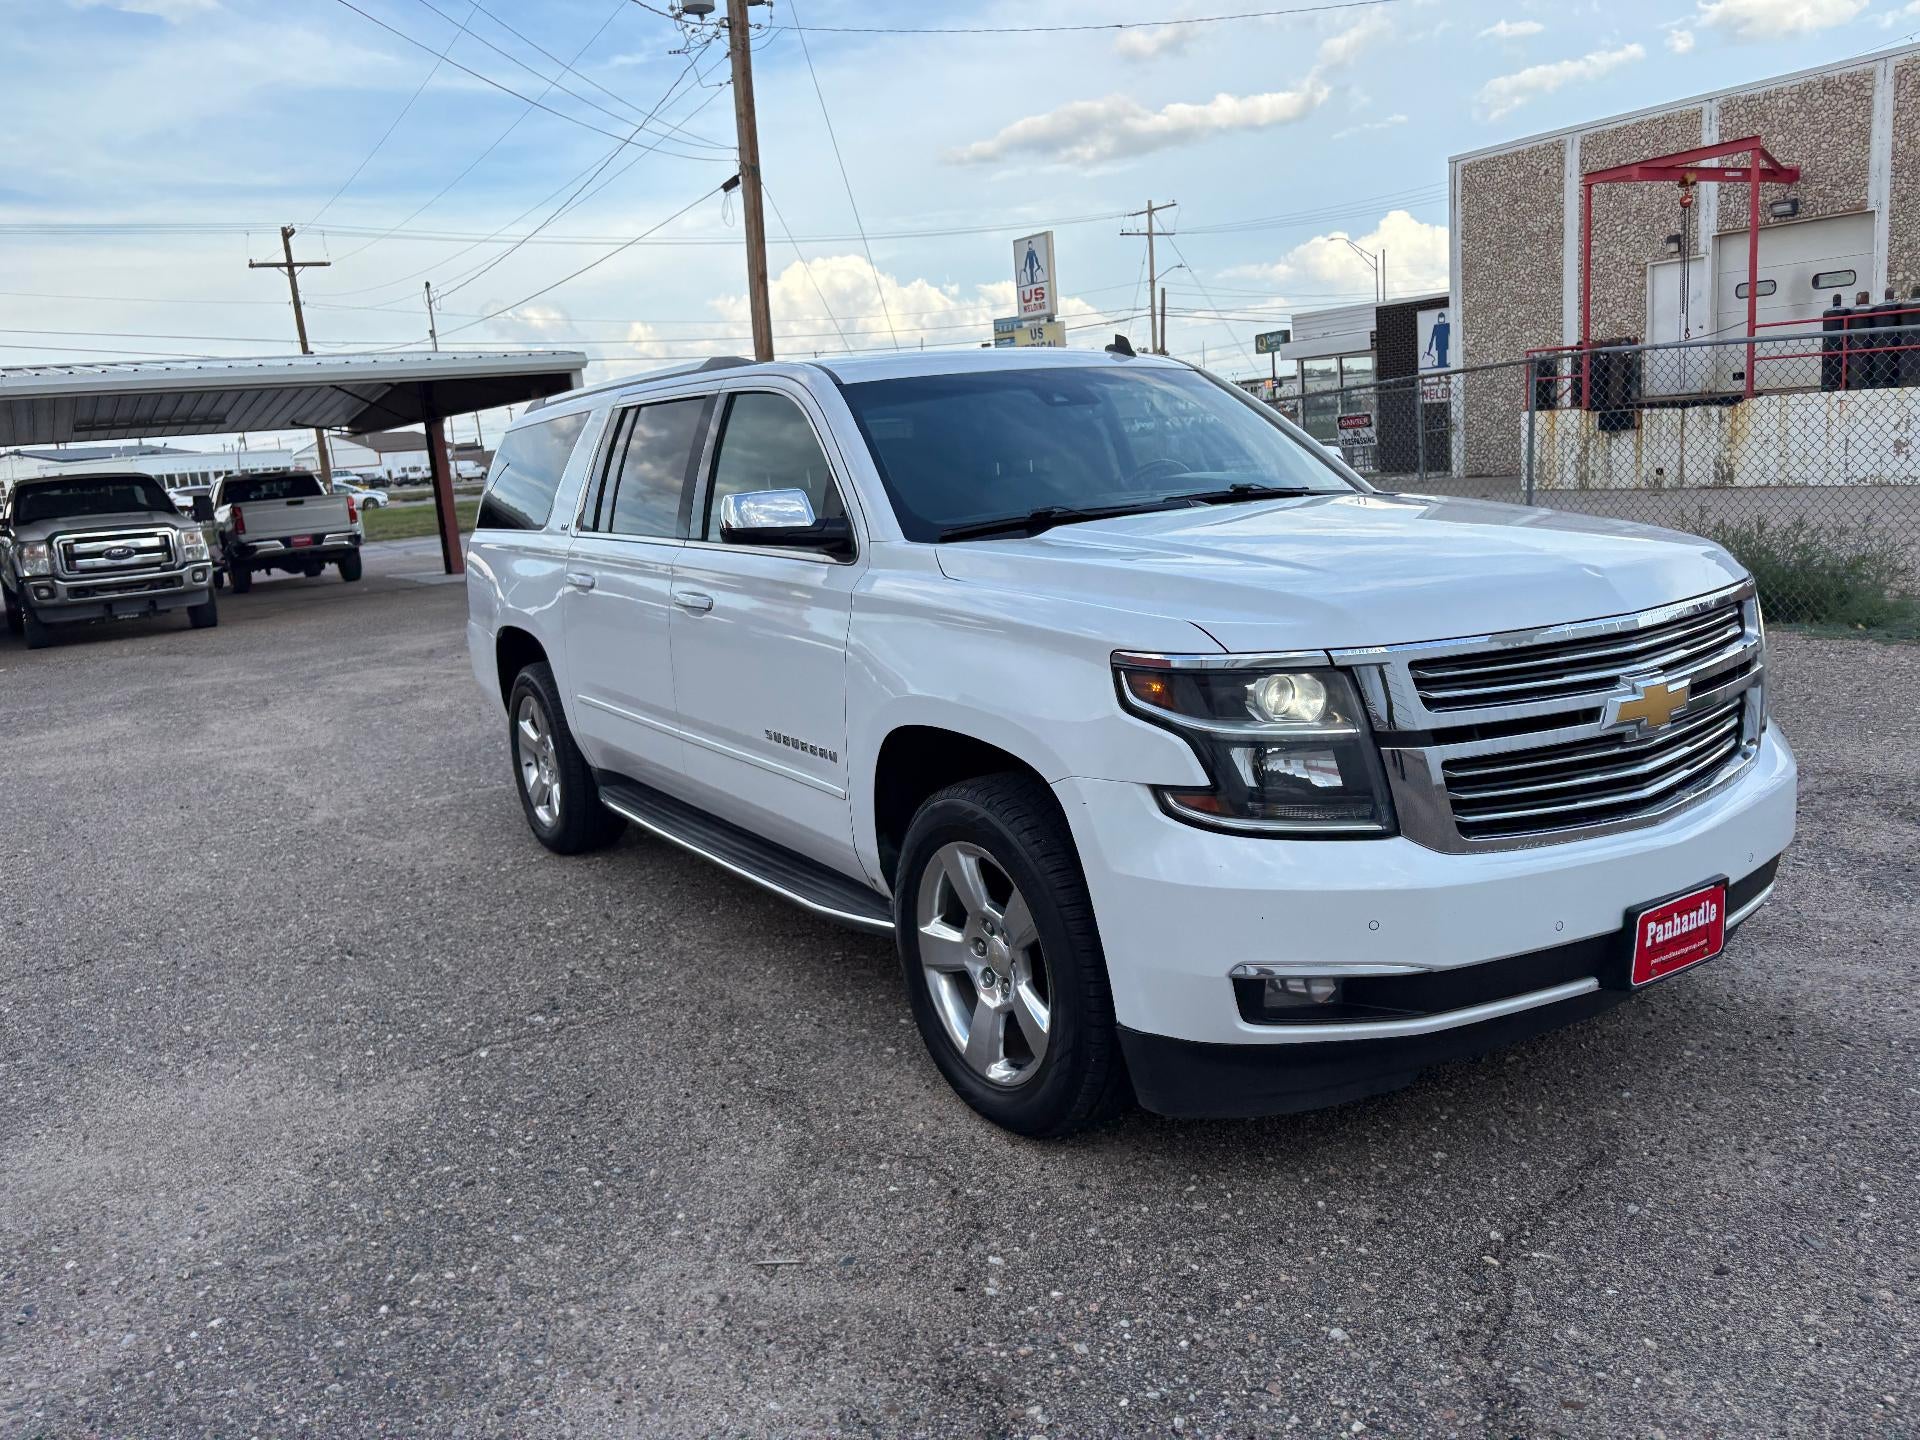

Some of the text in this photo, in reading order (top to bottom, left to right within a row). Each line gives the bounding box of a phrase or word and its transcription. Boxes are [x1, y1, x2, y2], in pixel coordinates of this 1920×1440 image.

[1022, 286, 1045, 304] US
[1023, 302, 1046, 313] WELDING
[1030, 327, 1044, 340] US
[1352, 429, 1361, 438] NO
[764, 729, 838, 763] SUBURBAN
[1645, 900, 1717, 948] Panhandle
